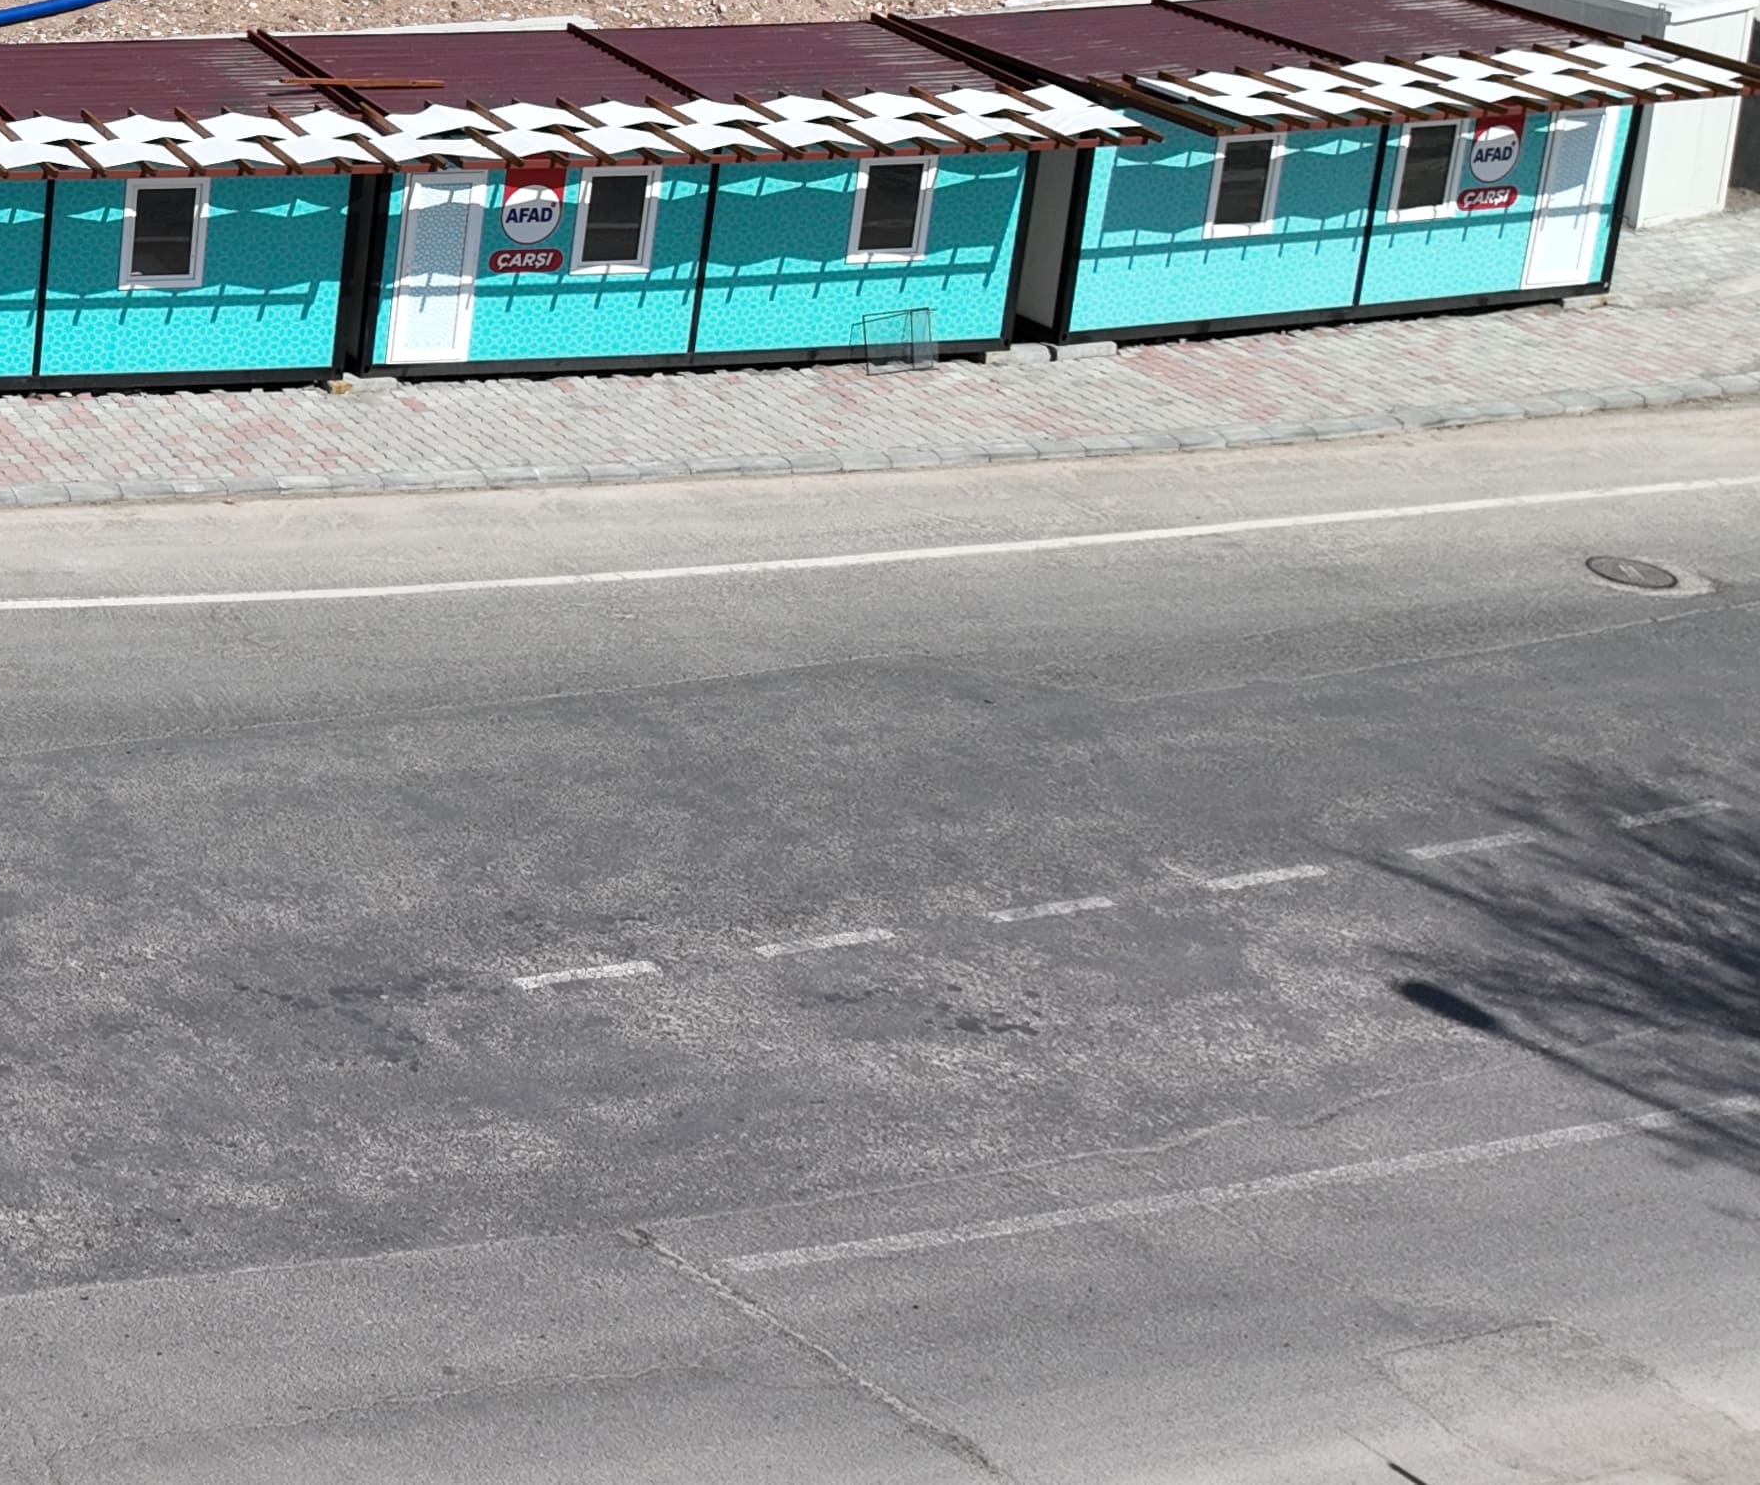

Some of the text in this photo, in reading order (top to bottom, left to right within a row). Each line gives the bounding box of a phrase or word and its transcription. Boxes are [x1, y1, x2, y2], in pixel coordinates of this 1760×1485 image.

[1473, 146, 1512, 163] AFAD
[1463, 189, 1510, 208] ÇARŞI
[505, 207, 553, 223] AFAD
[497, 252, 554, 270] ÇARŞI
